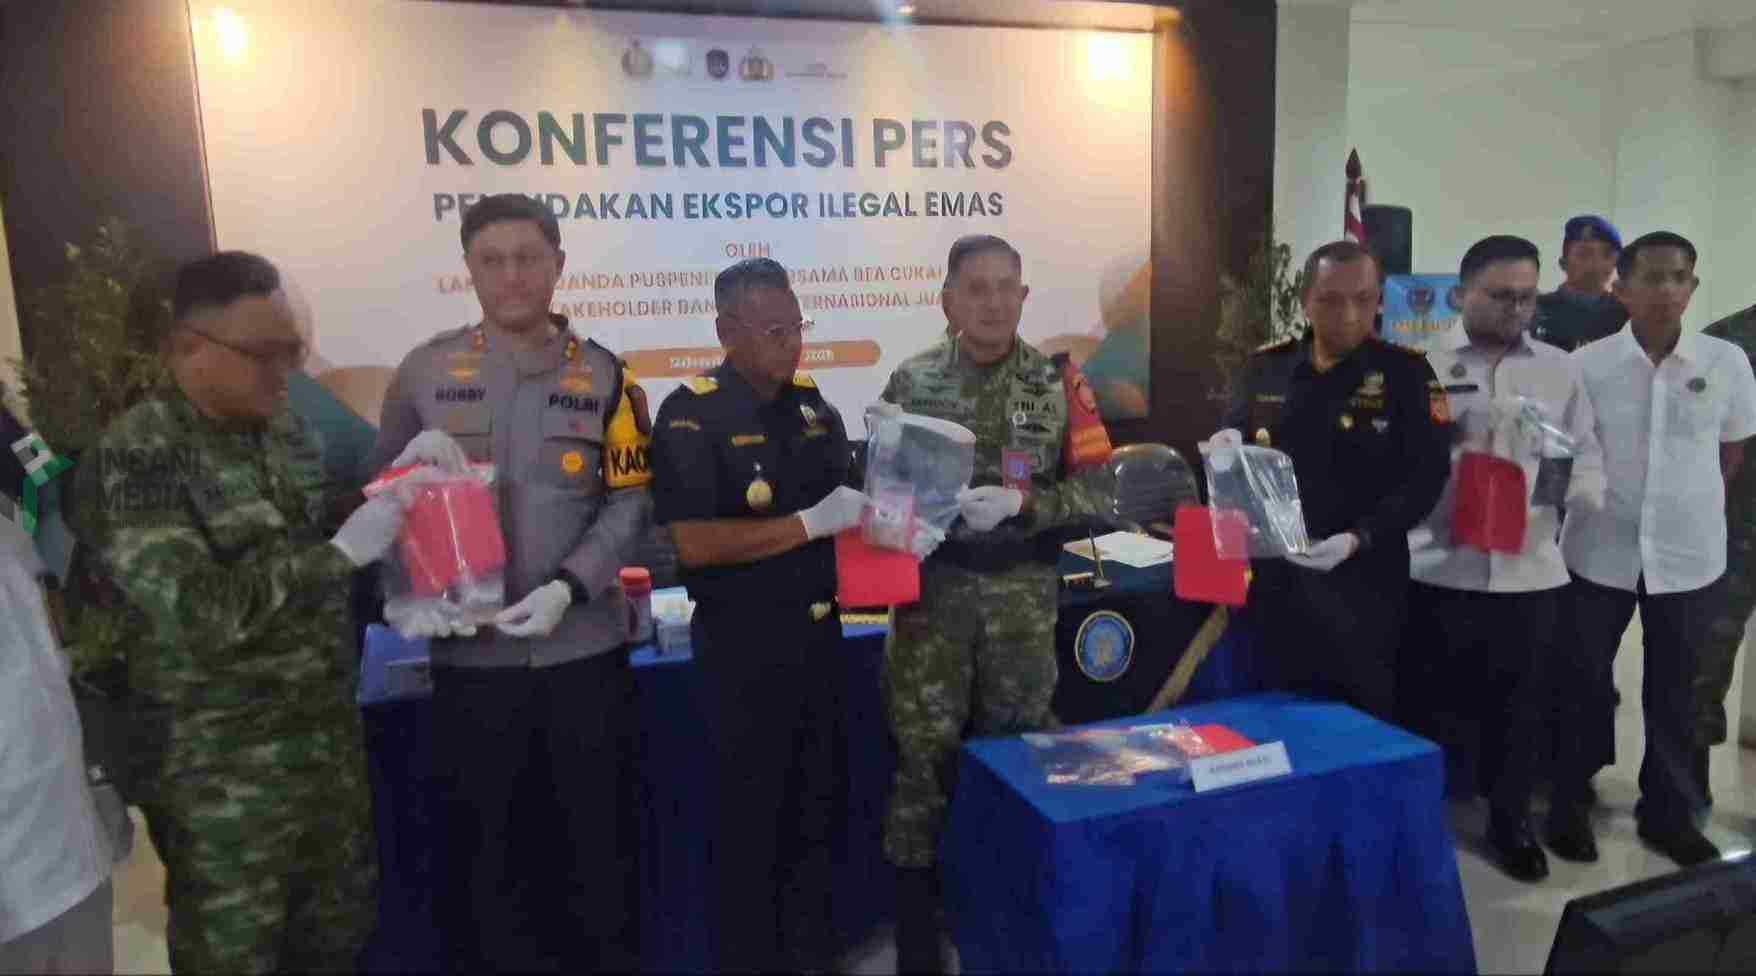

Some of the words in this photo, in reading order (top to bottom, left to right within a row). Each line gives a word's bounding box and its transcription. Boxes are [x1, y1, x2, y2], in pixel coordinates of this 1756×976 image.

[422, 108, 854, 168] KONFERENSI
[873, 117, 1012, 169] PERS
[433, 192, 673, 220] PEDAKAN
[683, 192, 809, 219] EKSPOR
[818, 192, 917, 217] ILEGAL
[925, 191, 1004, 217] EMAS
